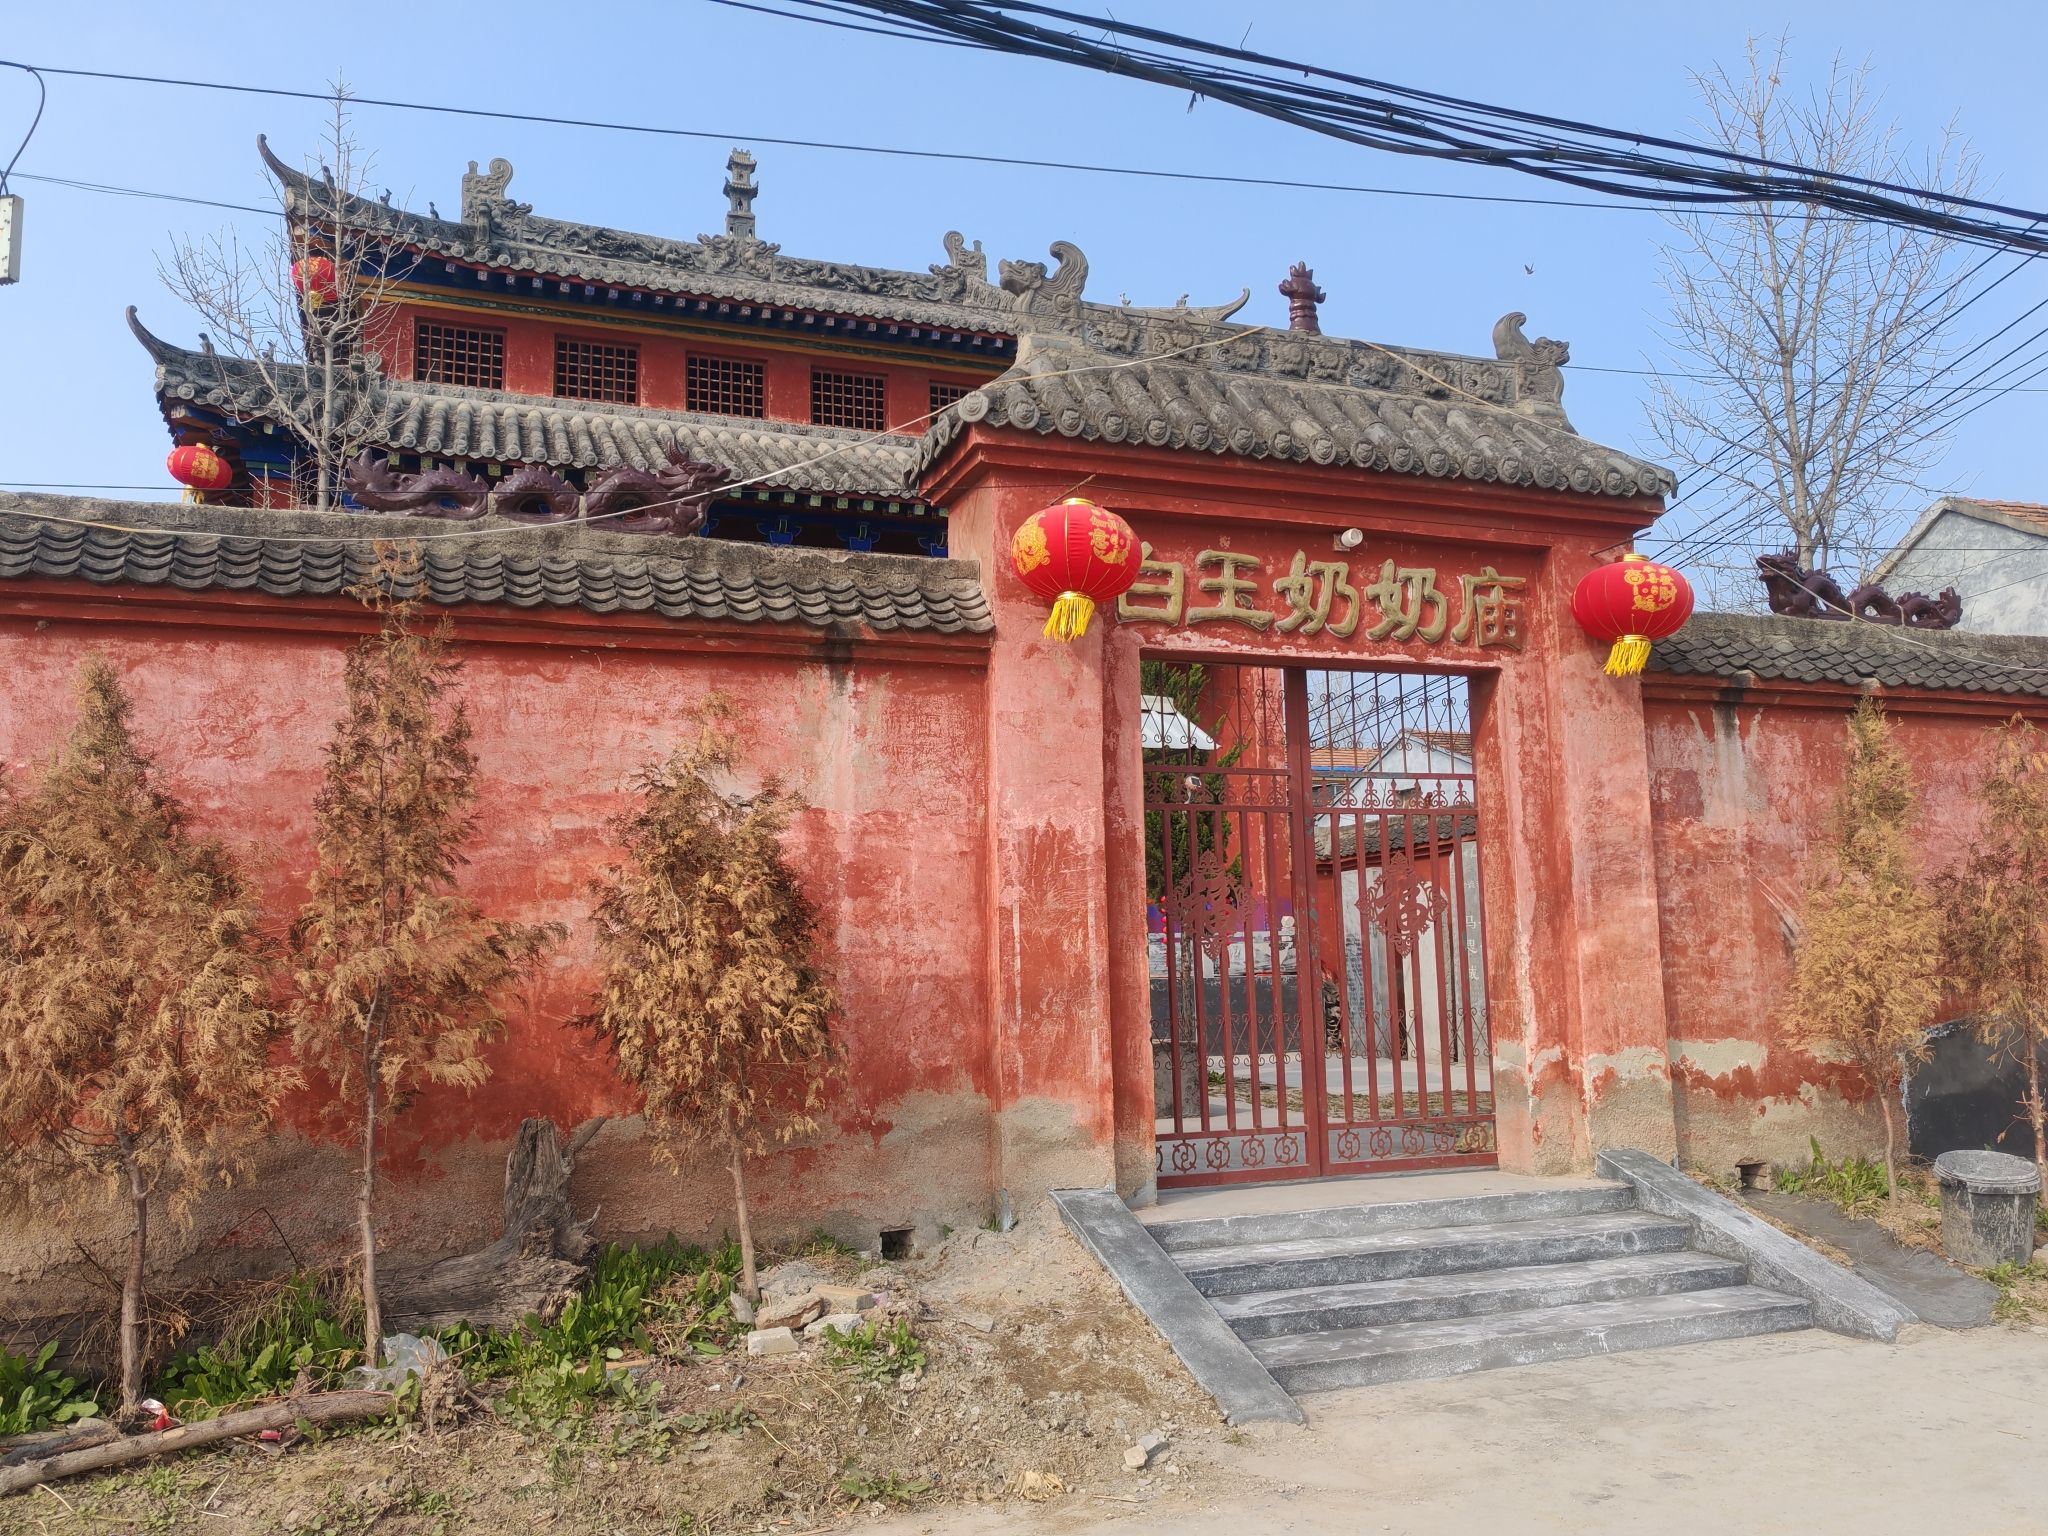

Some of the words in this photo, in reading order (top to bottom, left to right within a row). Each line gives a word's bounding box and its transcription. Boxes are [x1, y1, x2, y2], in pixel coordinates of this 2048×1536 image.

[1115, 541, 1526, 650] 白玉奶奶庙
